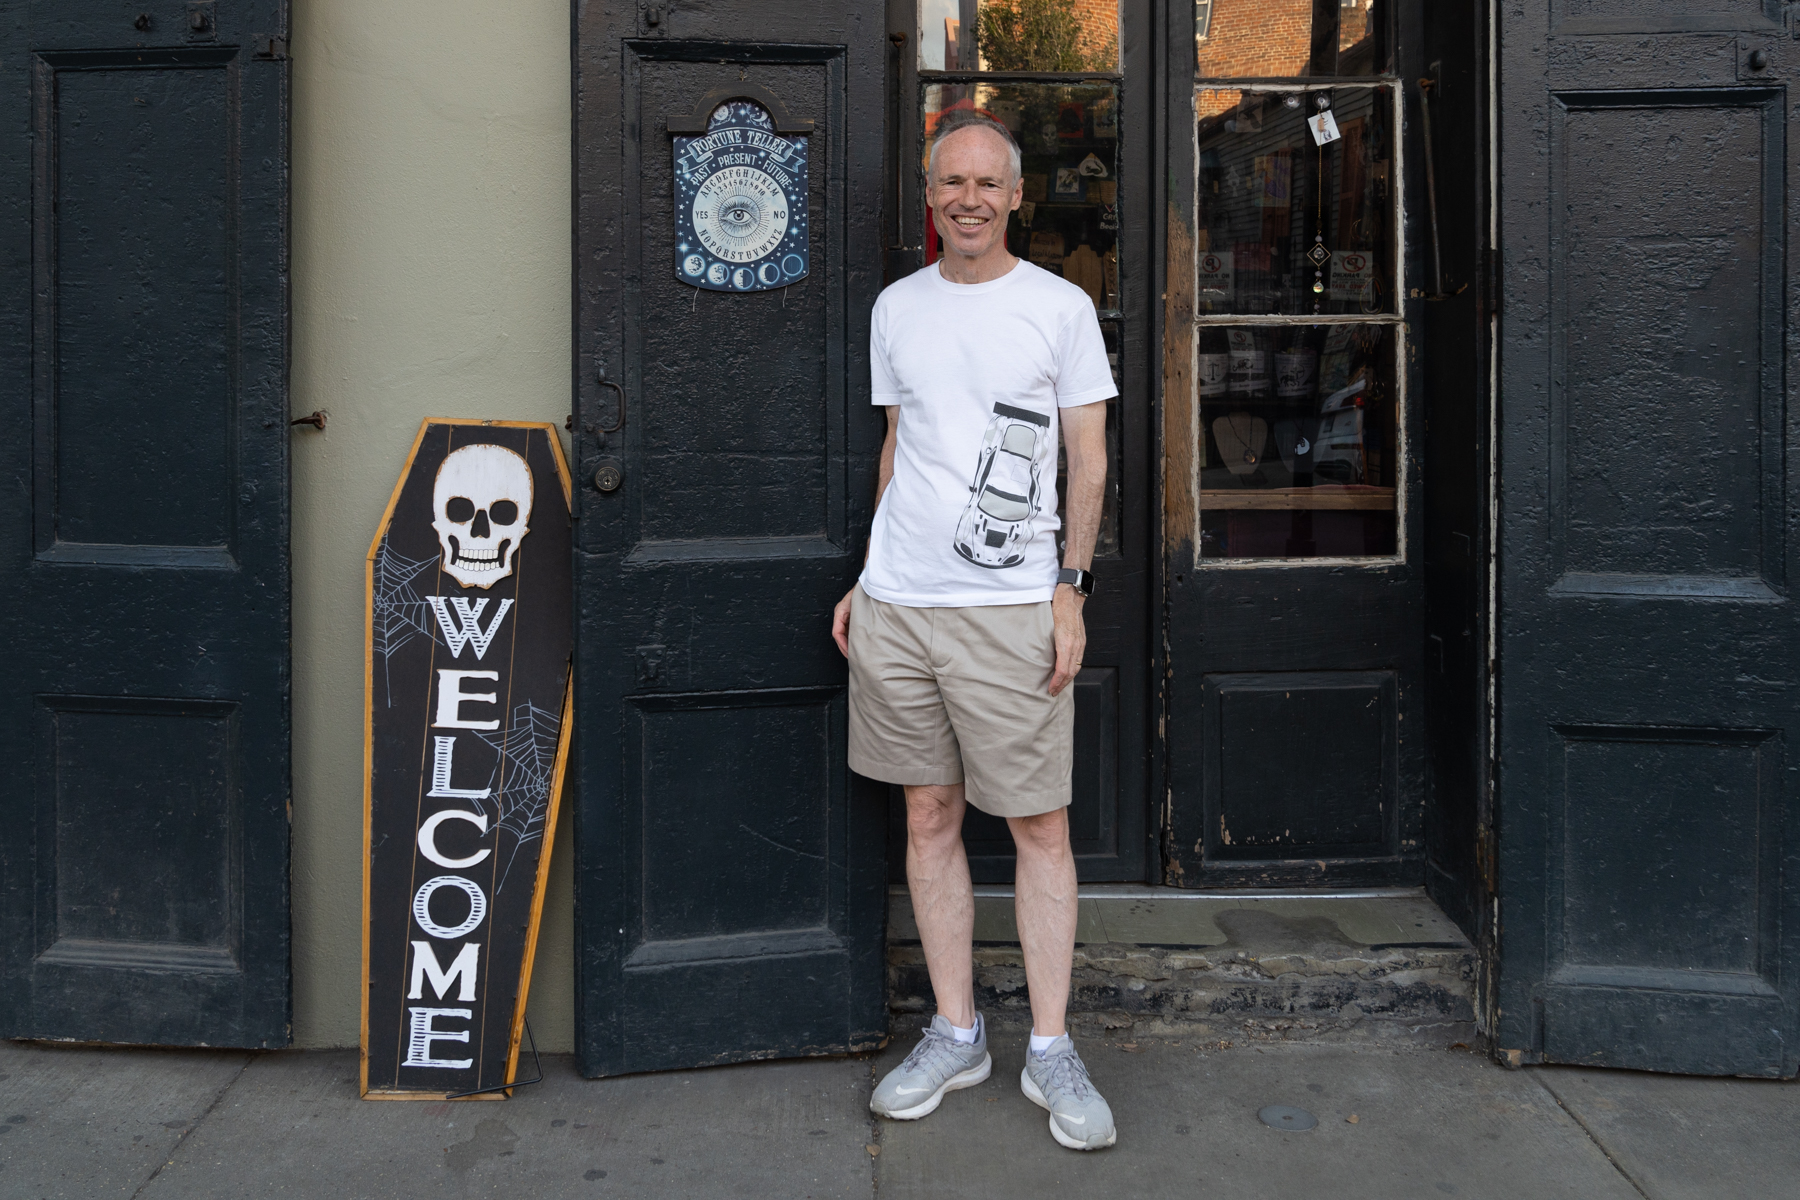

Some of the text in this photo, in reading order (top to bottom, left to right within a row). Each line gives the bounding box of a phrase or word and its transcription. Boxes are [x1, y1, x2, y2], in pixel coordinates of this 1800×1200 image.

[693, 129, 787, 155] FORTUNE TELLER
[690, 152, 793, 188] PAST PRESENT FUTURE
[695, 210, 709, 220] YES
[773, 210, 786, 220] NO
[401, 595, 515, 1068] WELCOME
